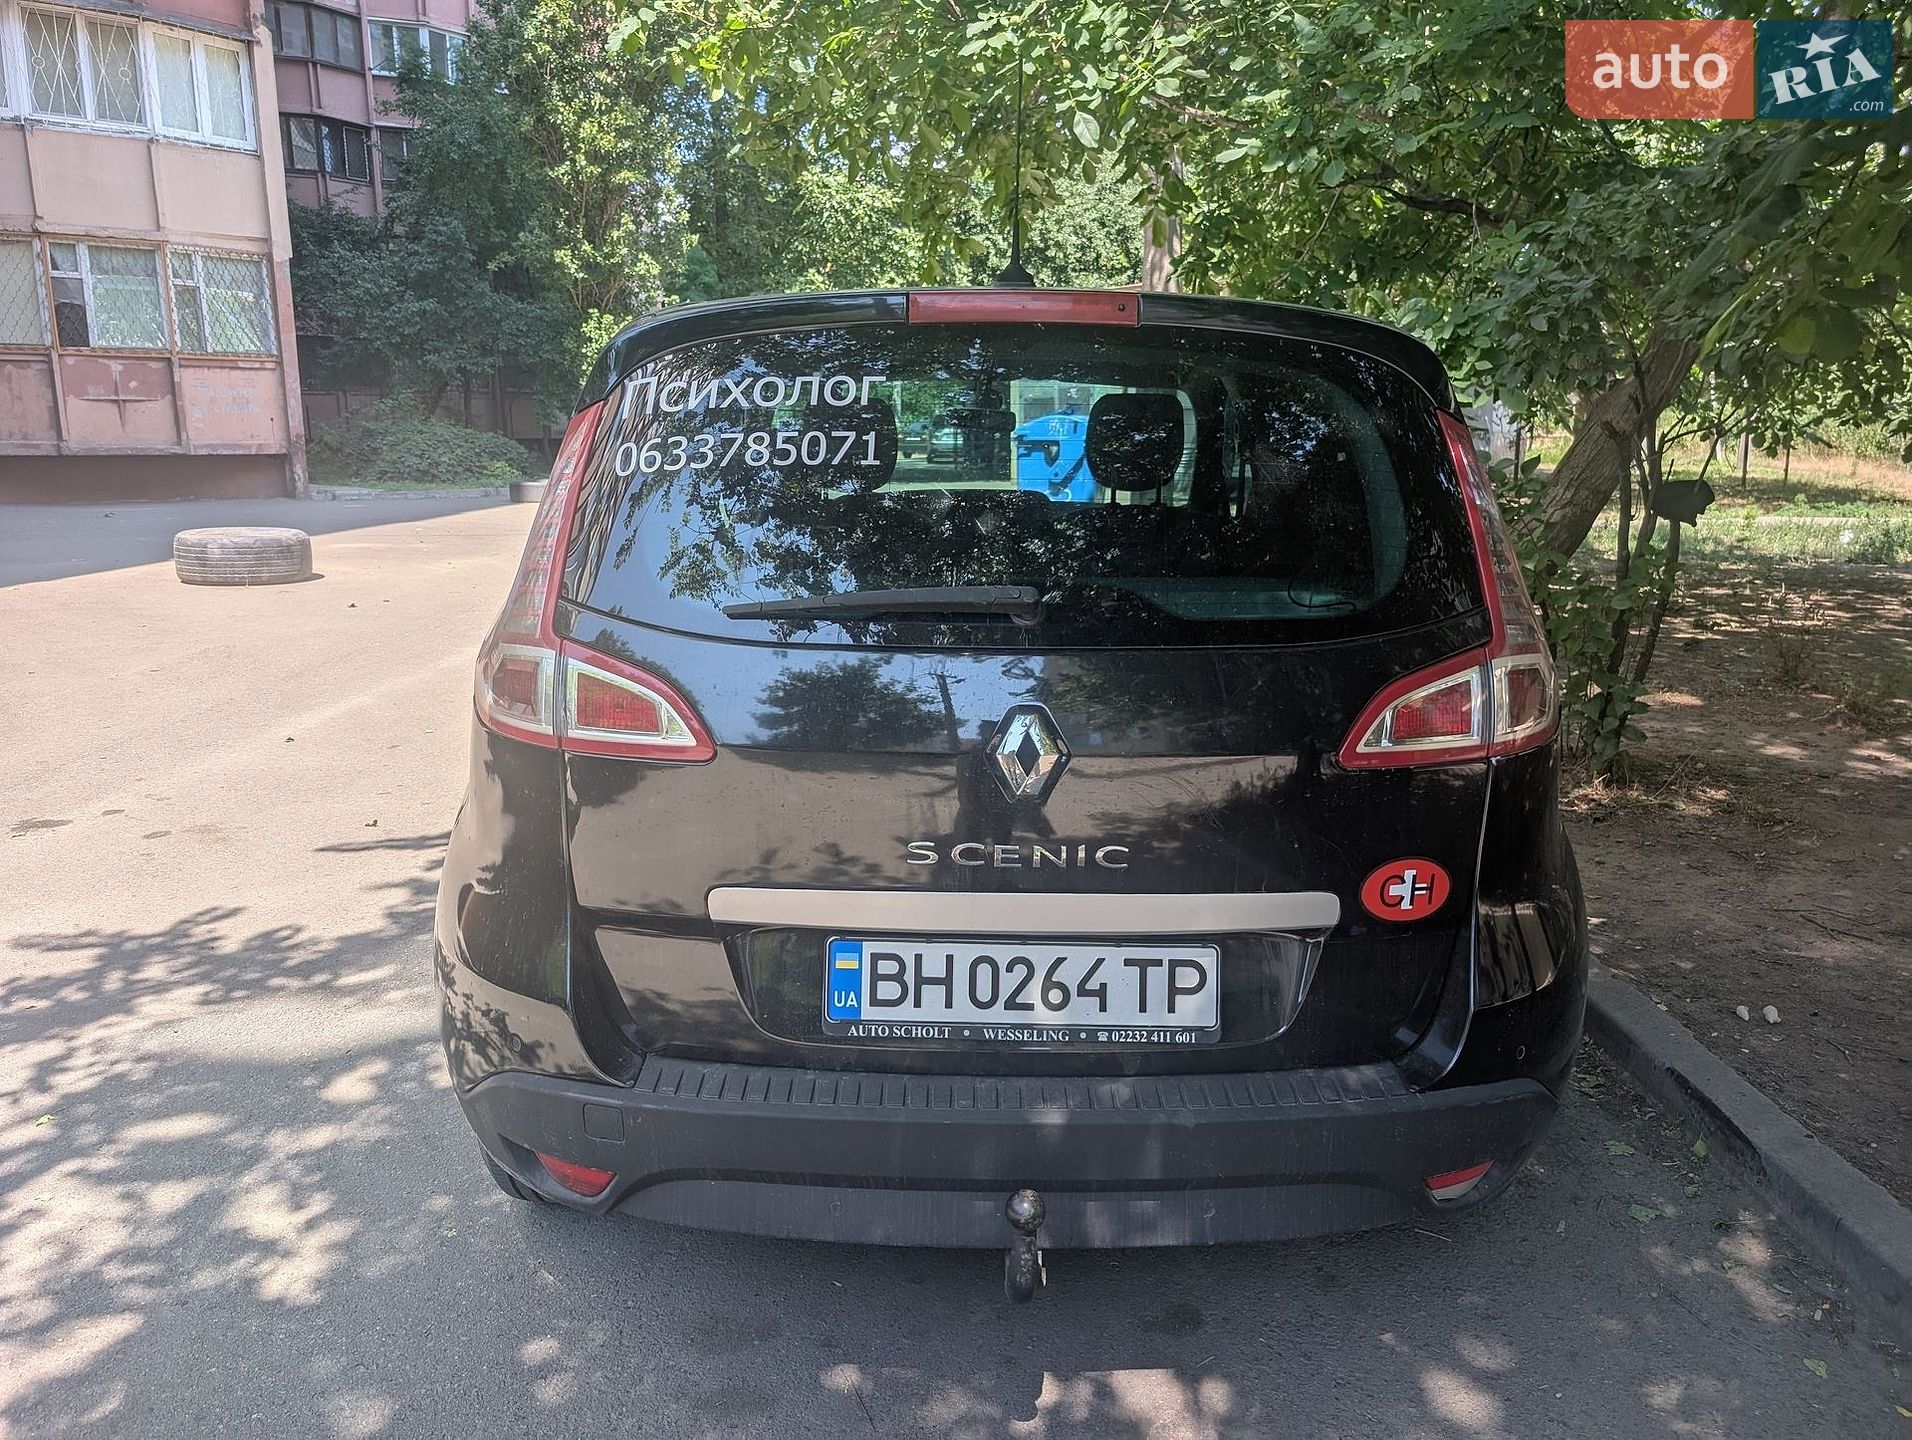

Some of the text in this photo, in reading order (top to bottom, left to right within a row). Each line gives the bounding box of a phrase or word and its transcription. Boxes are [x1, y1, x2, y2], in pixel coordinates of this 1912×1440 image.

[622, 375, 887, 420] Психолог
[614, 430, 881, 477] 0633785071
[906, 841, 1129, 868] SCENIC
[833, 990, 858, 1008] UA
[868, 952, 1208, 1014] BH 0264 TP
[847, 1024, 1196, 1044] AUTO SCHOLT WESSELING 02232 411 601
